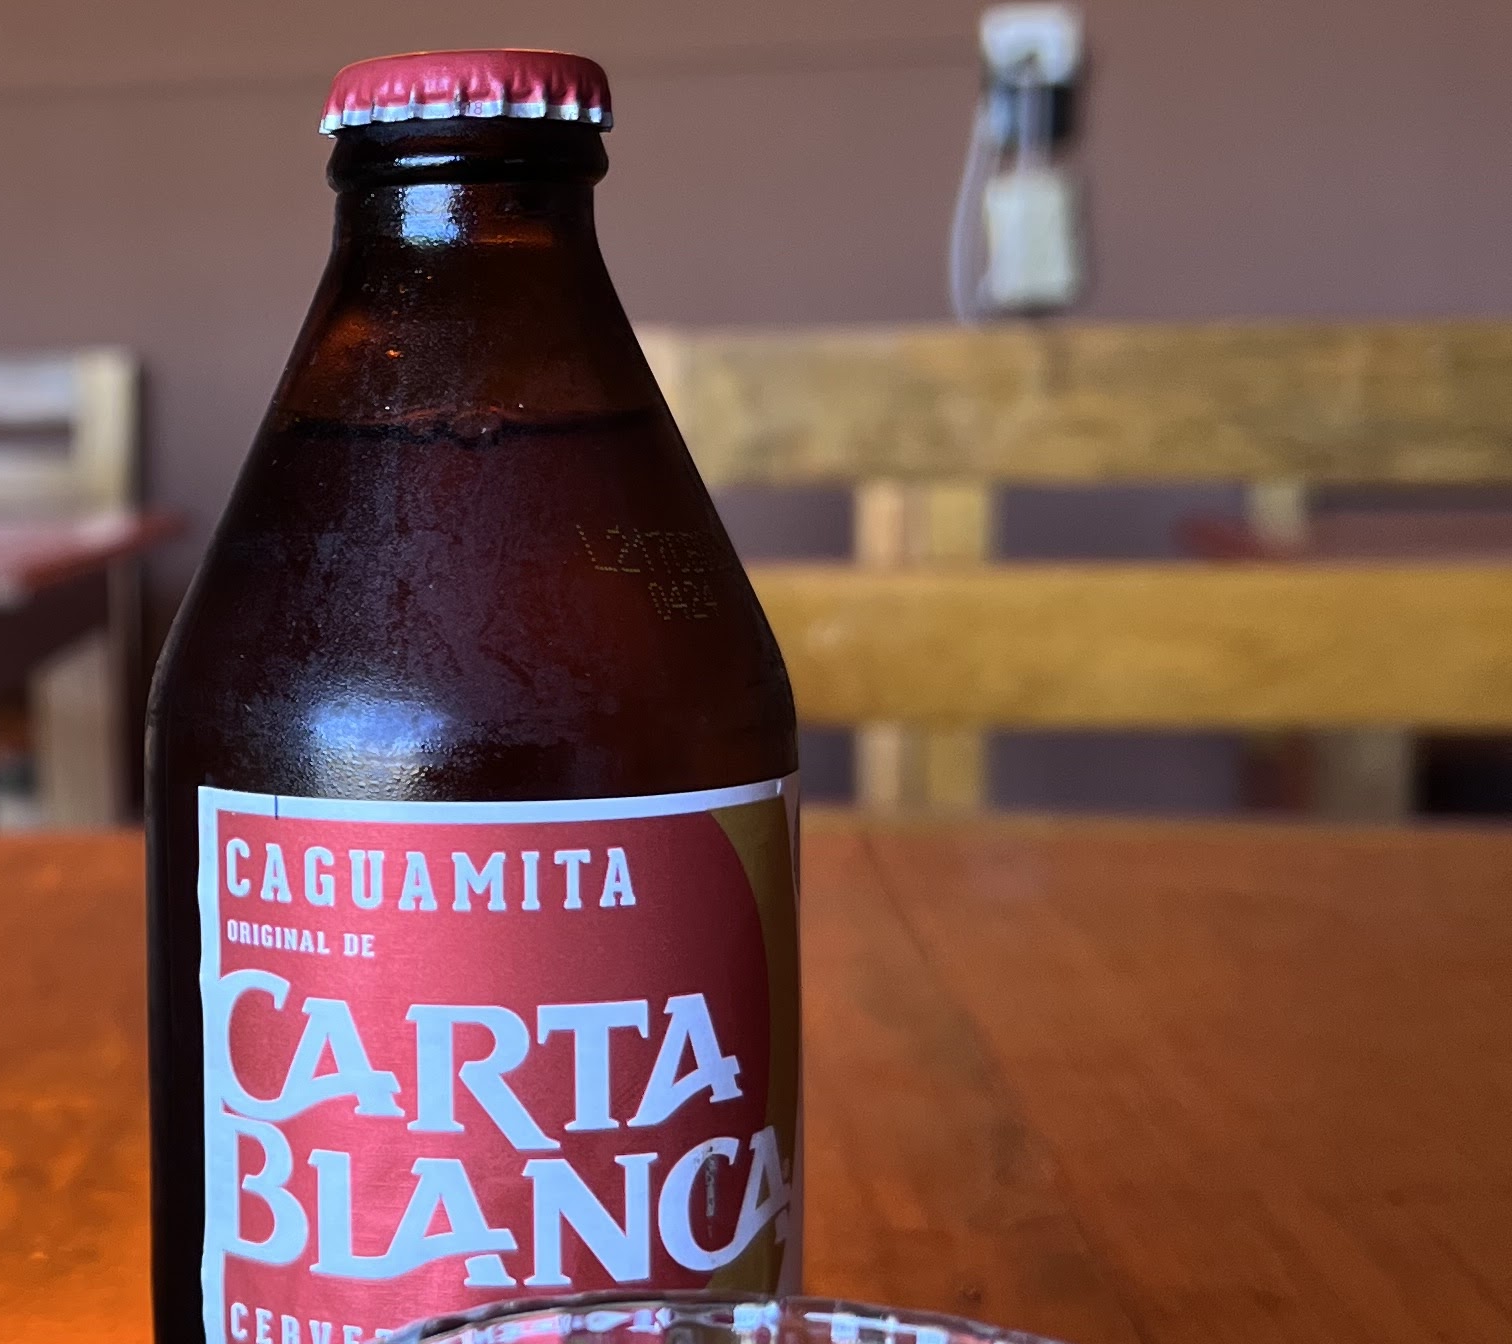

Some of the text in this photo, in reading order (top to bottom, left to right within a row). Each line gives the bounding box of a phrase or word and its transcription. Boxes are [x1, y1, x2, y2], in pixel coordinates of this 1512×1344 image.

[225, 837, 637, 912] CAGUAMITA
[226, 918, 376, 958] ORIGINAL DE
[217, 968, 742, 1151] CARTA
[218, 1116, 792, 1289] BLANCA
